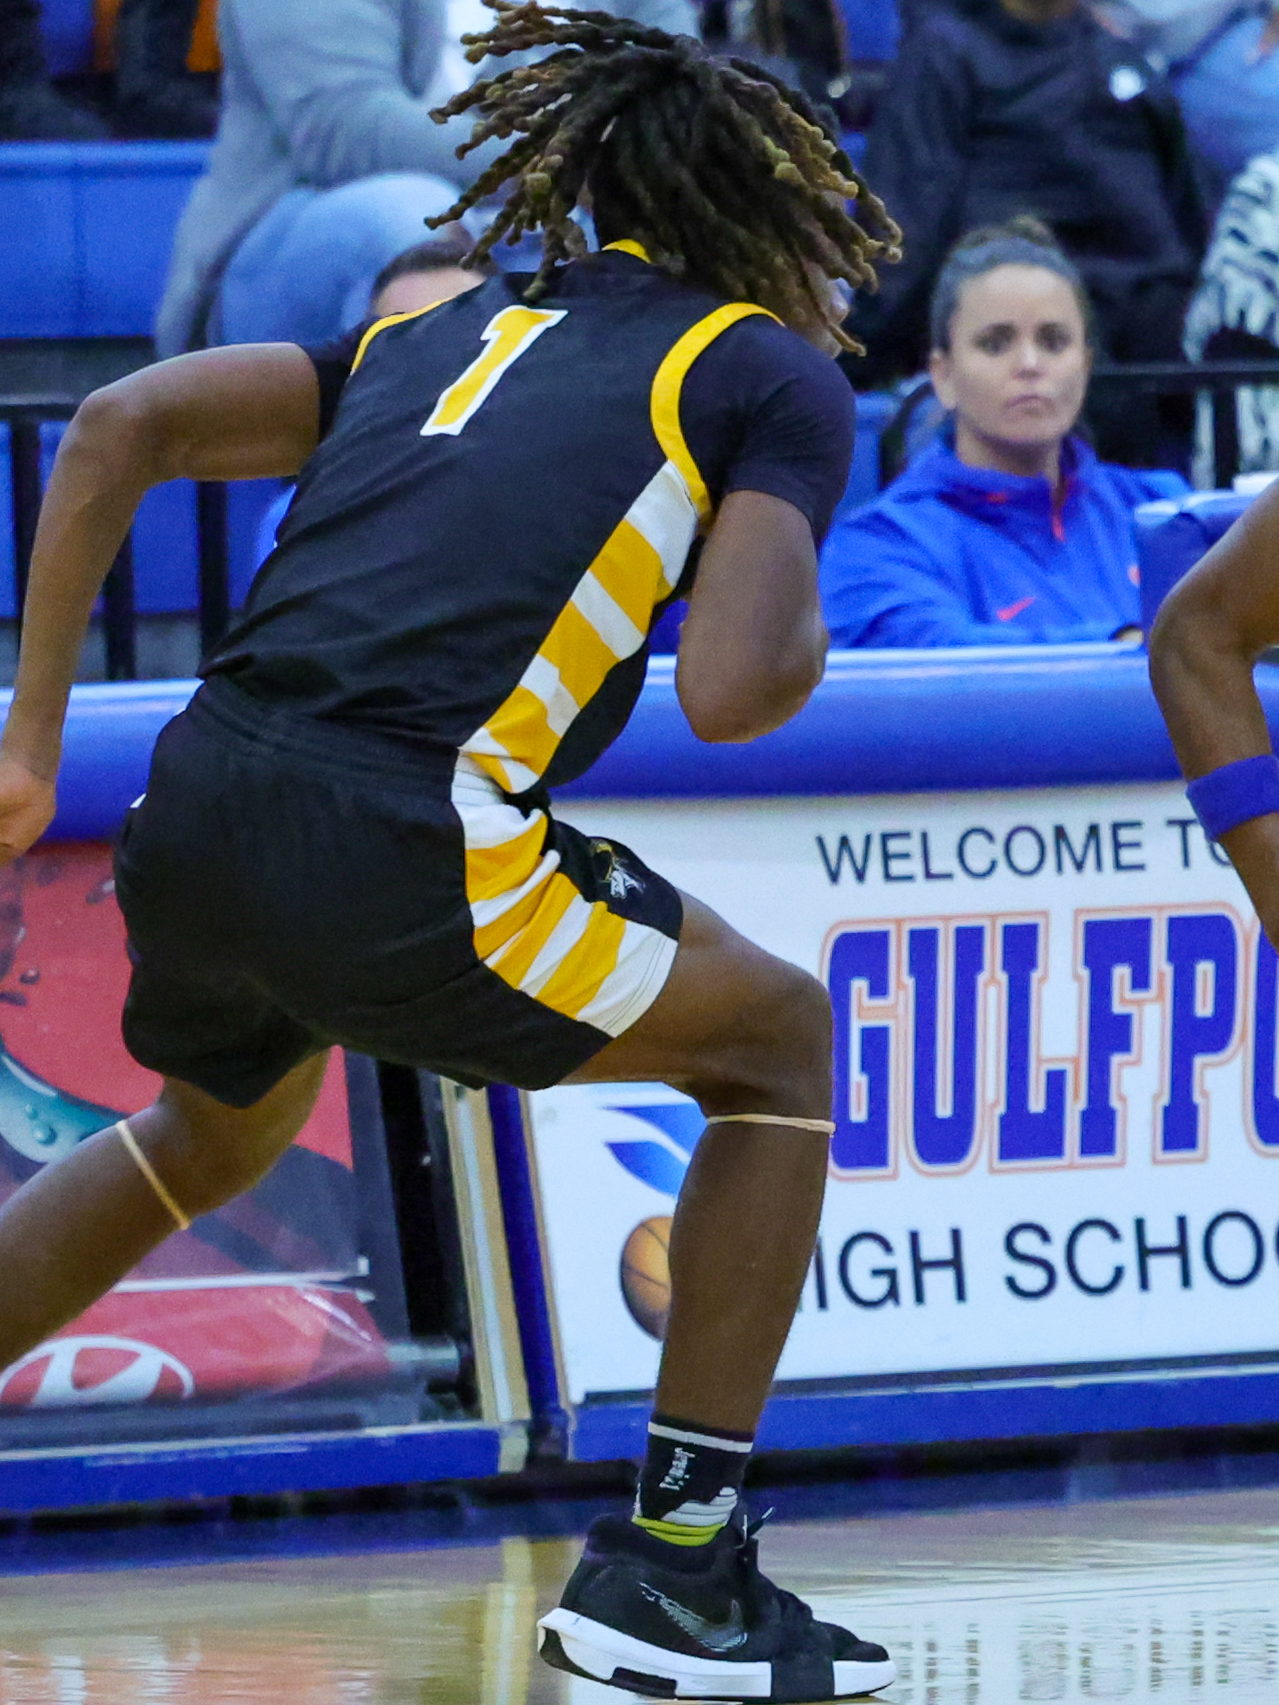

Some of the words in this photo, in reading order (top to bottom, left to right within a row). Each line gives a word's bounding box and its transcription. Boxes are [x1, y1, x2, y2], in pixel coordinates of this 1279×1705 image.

[419, 304, 568, 437] 1
[816, 822, 1147, 885] WELCOME
[799, 1226, 968, 1313] IGH
